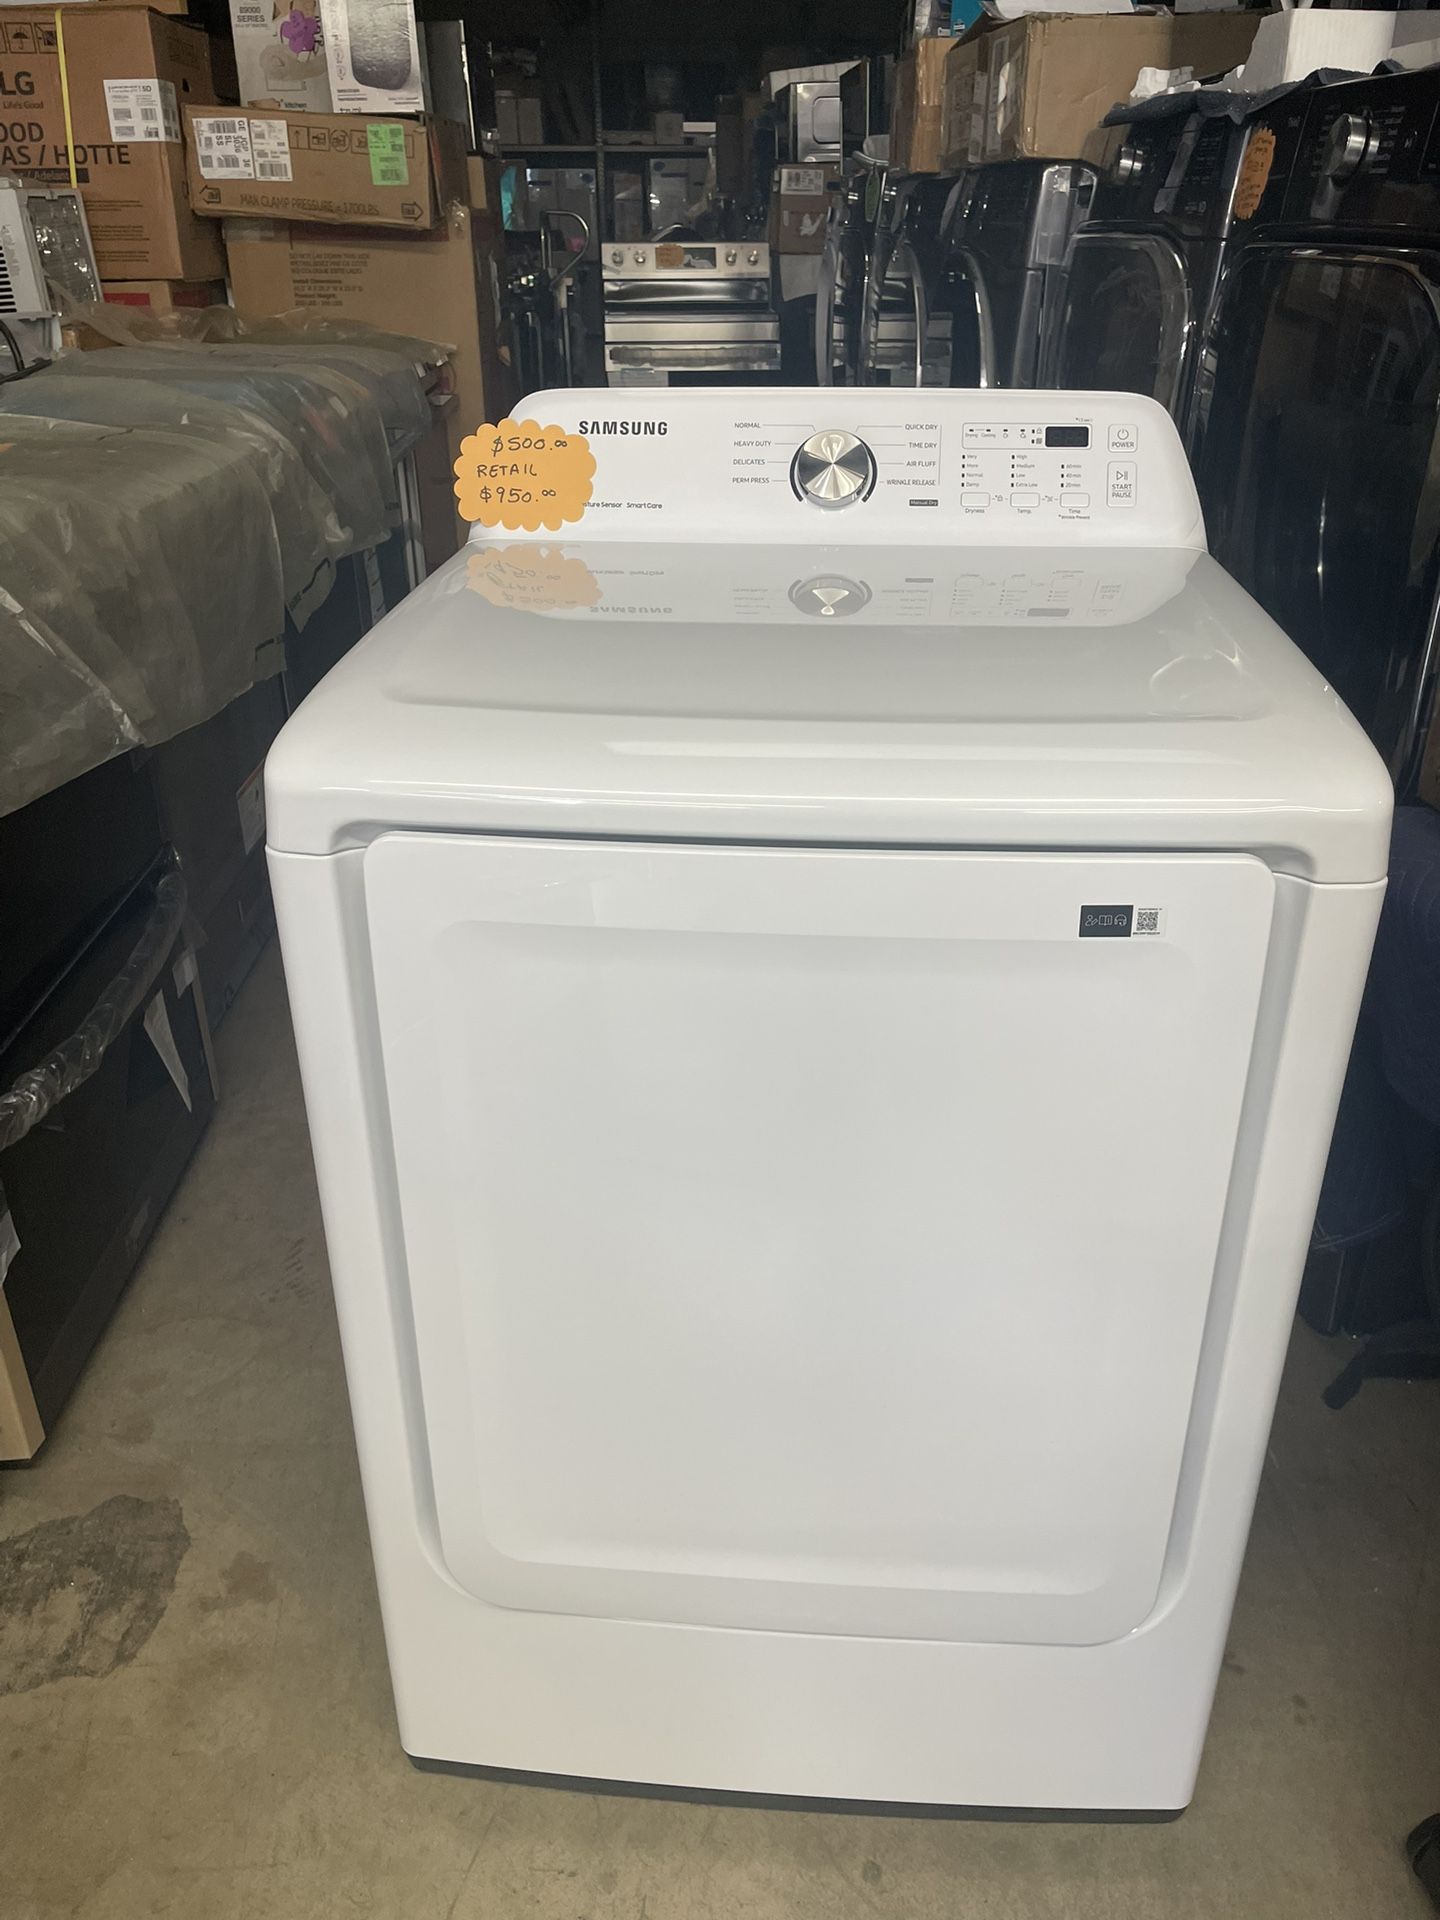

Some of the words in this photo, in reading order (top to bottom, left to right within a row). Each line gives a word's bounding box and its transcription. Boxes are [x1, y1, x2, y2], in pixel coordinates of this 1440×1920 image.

[236, 14, 265, 23] SERIES
[0, 71, 35, 95] LG
[23, 100, 44, 110] Good
[53, 144, 131, 165] HOTTE
[578, 420, 668, 436] SAMSUNG
[476, 463, 538, 478] RETAIL
